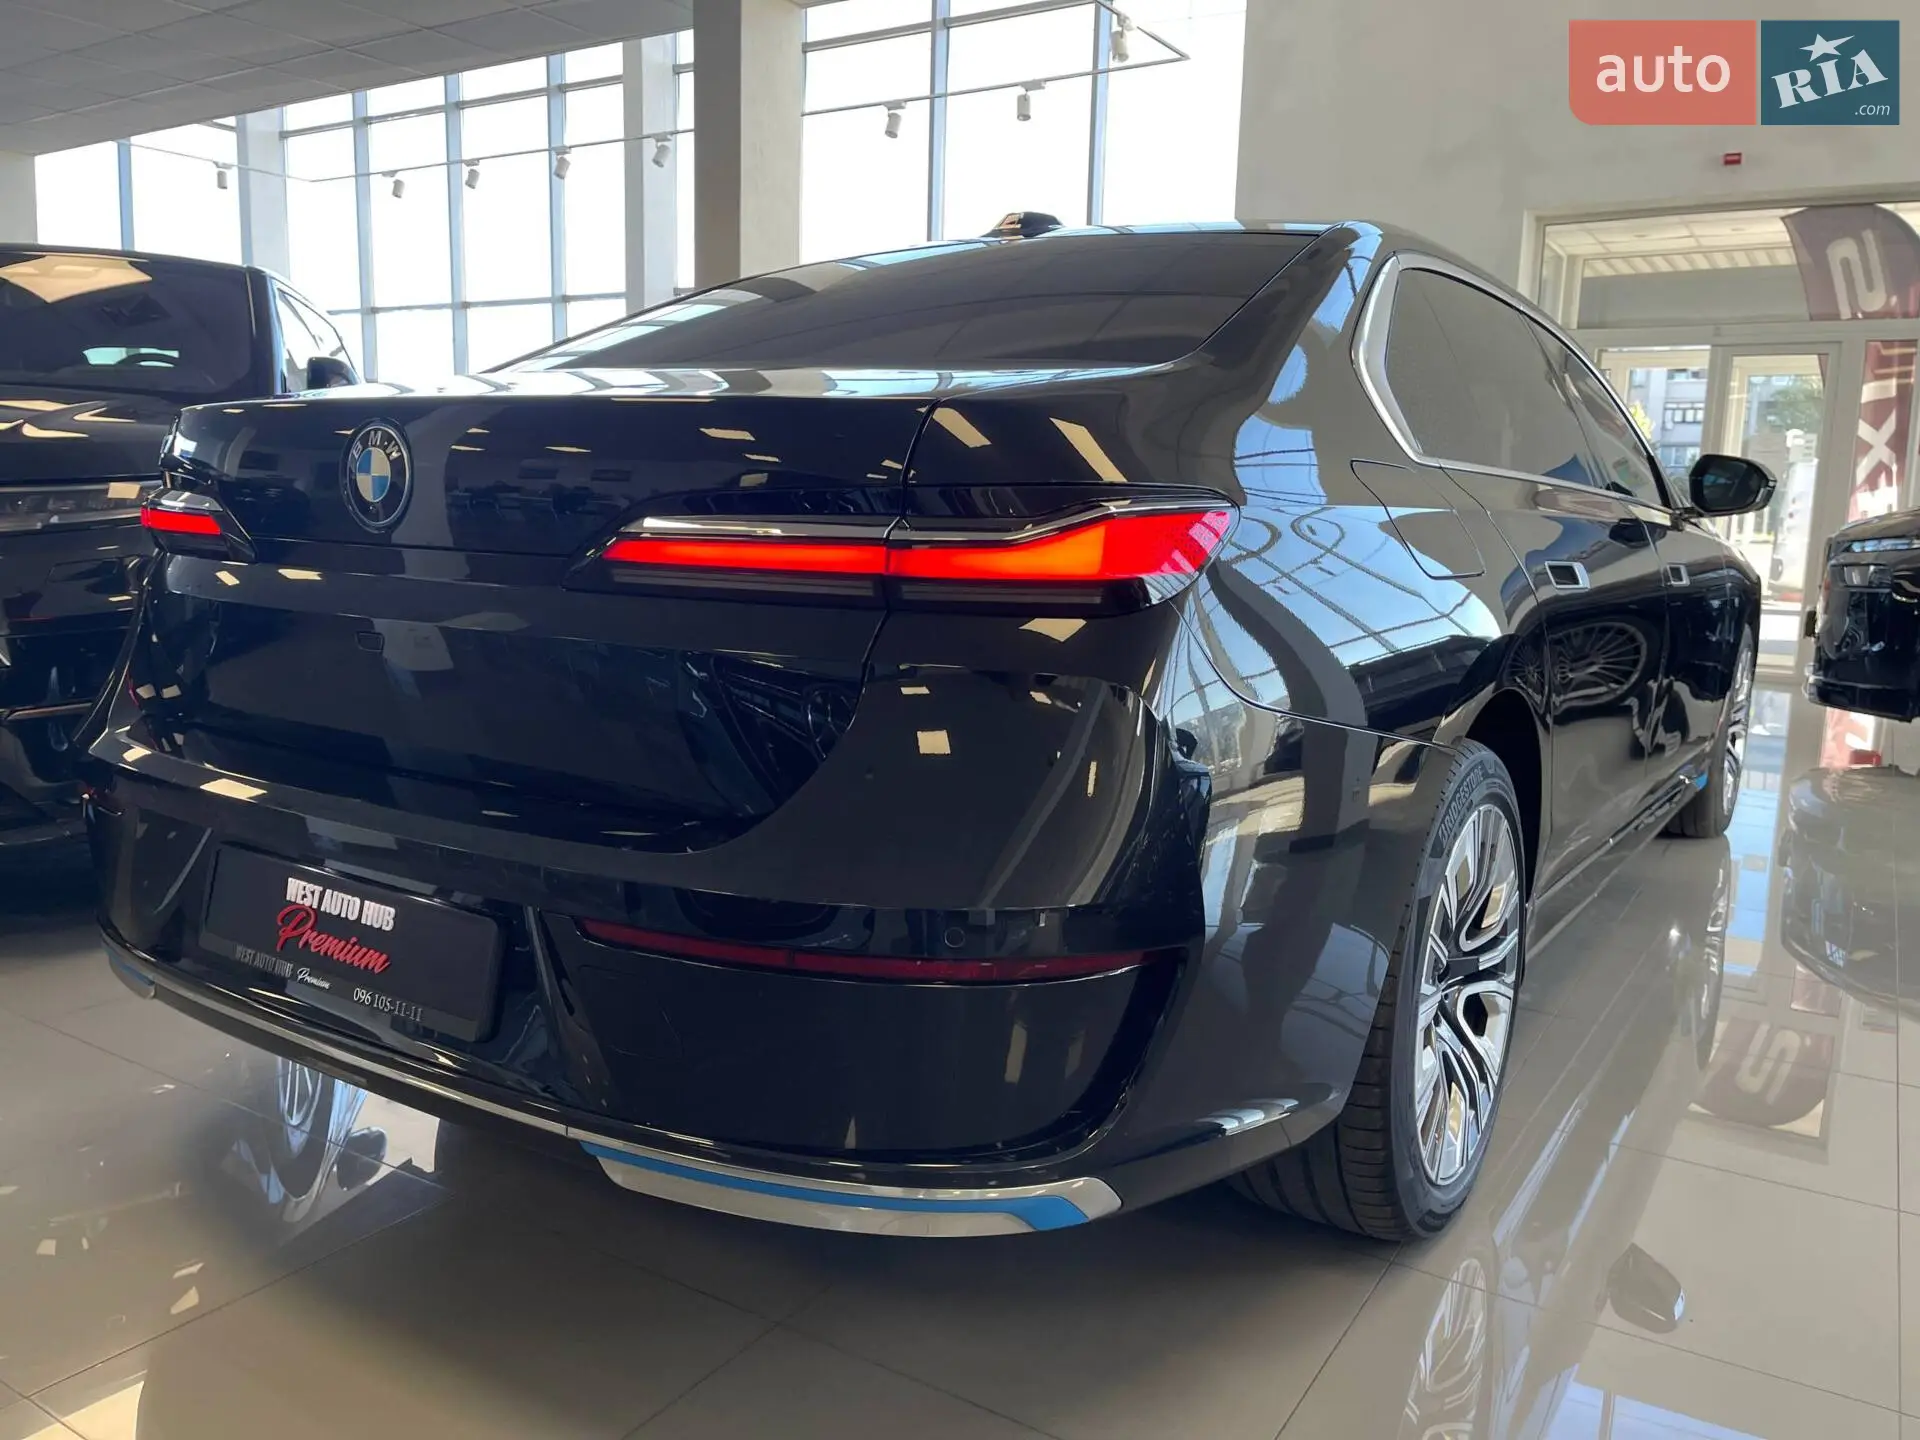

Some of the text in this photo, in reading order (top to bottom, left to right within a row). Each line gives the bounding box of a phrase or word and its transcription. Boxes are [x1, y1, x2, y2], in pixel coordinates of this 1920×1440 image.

[352, 430, 402, 460] BMW
[286, 877, 396, 931] WEST AUTO HUB
[276, 903, 391, 974] Premium
[296, 966, 332, 990] Premium
[353, 986, 423, 1022] 096 105-11-11
